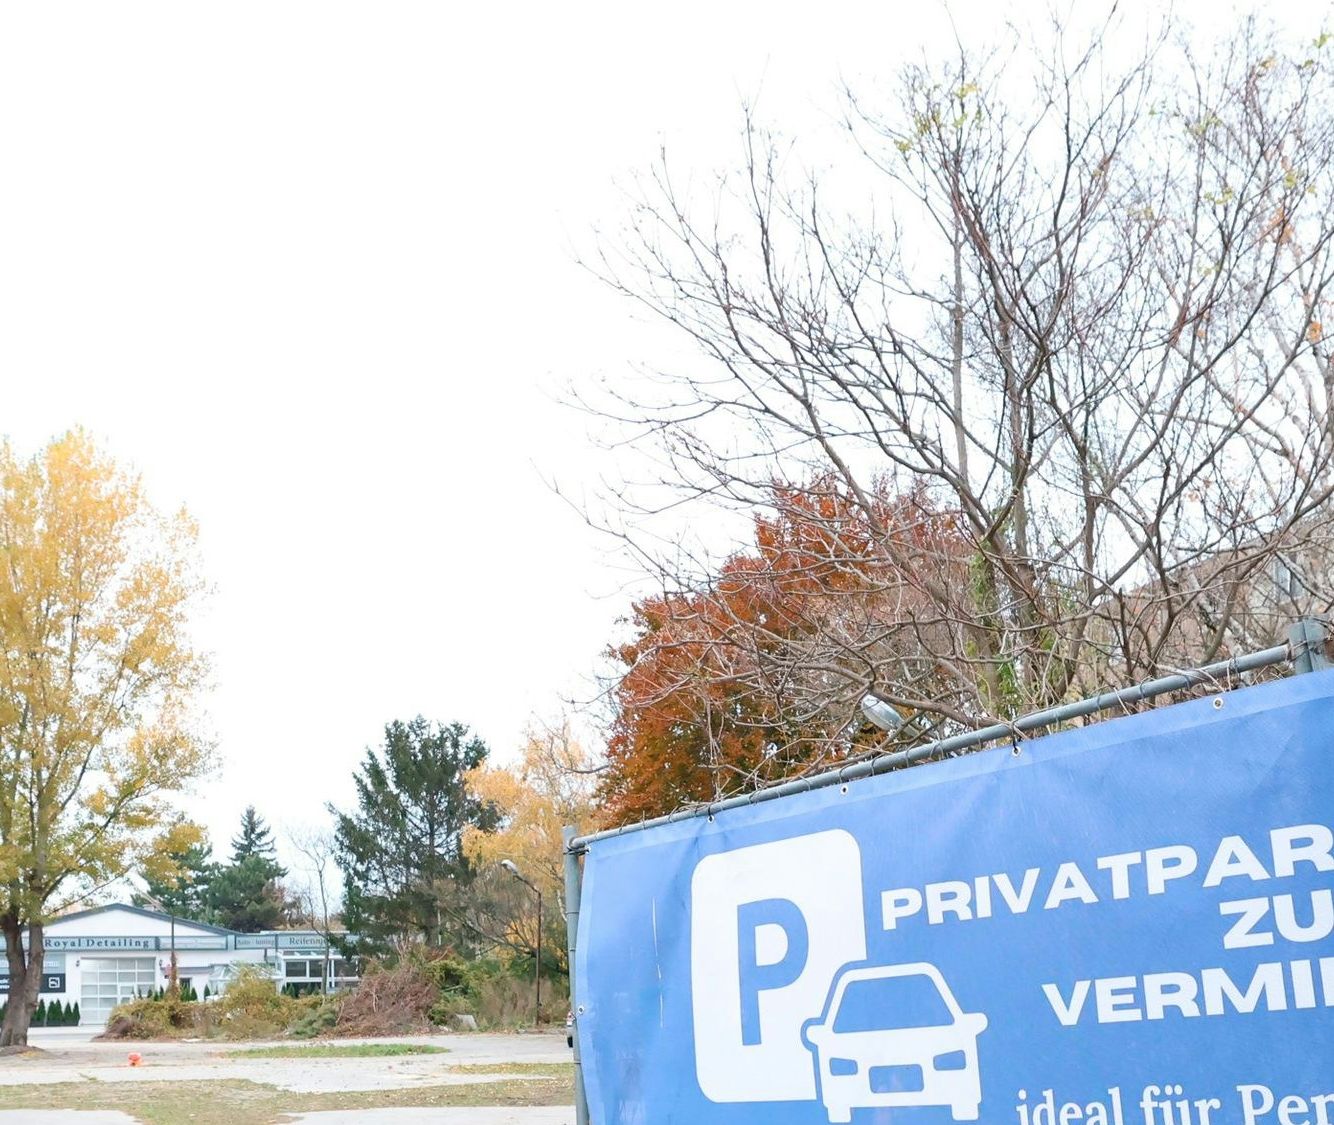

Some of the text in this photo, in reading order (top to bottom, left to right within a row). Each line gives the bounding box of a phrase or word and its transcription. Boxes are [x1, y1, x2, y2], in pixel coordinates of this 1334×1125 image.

[1219, 889, 1334, 949] ZU
[44, 937, 149, 949] Royal Detailing
